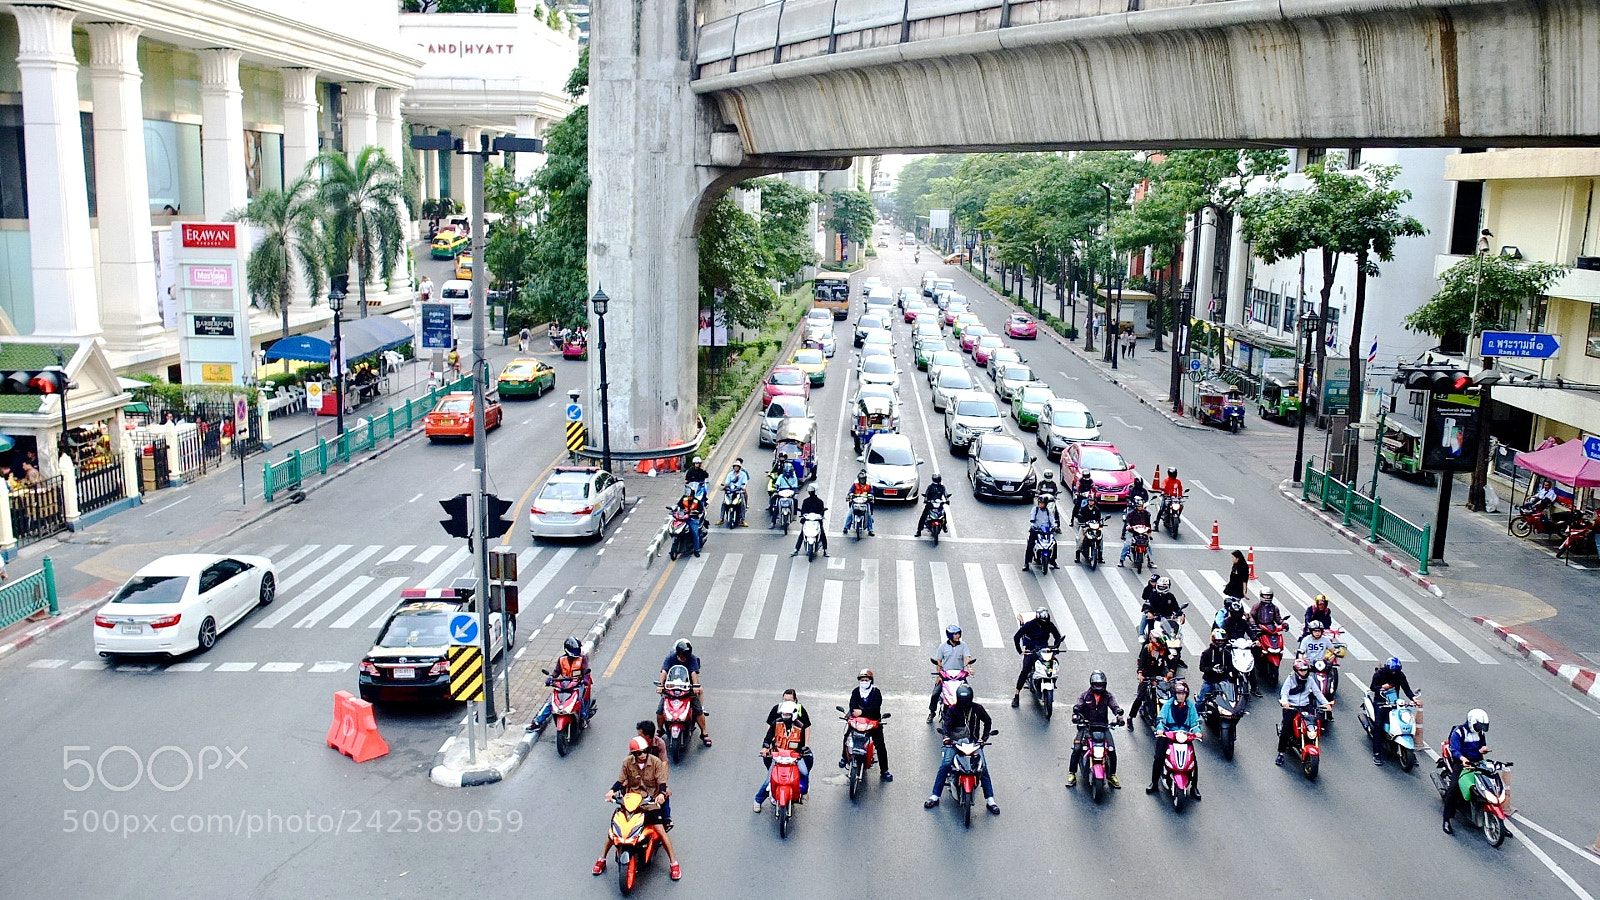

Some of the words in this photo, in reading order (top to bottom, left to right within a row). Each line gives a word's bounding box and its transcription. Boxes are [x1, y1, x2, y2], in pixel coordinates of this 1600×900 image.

[465, 44, 514, 54] HYATT
[186, 229, 230, 241] ERAWAN
[1498, 348, 1516, 356] Rama
[1307, 642, 1324, 651] 965
